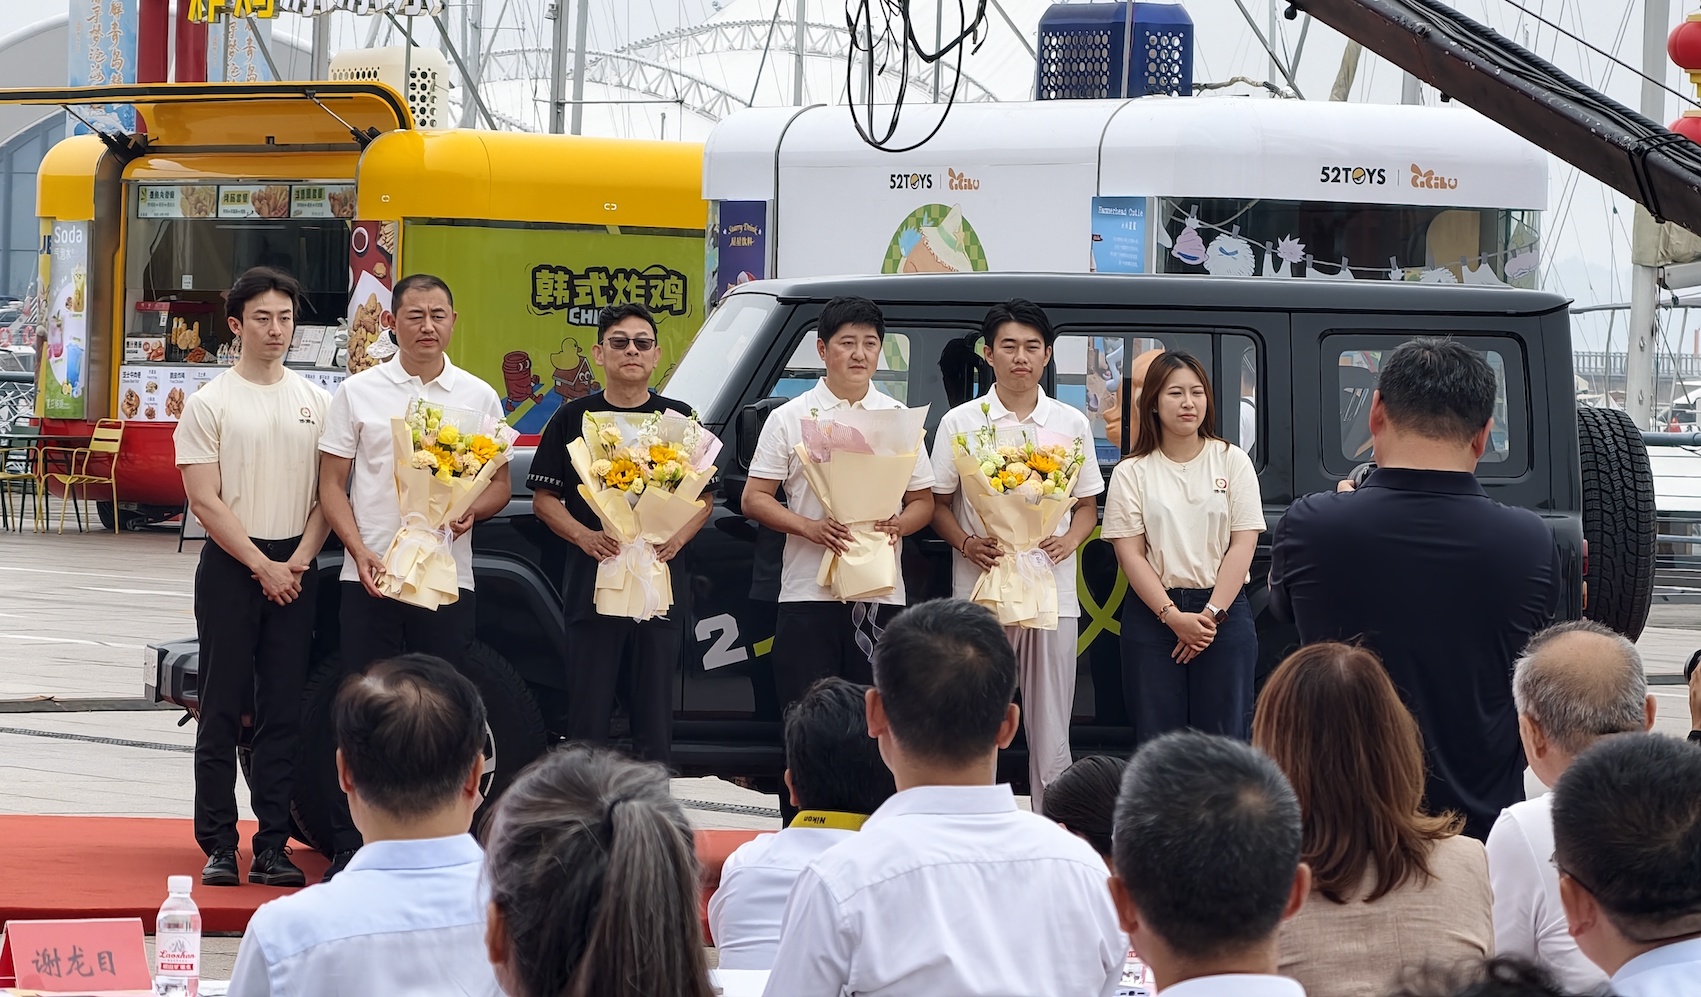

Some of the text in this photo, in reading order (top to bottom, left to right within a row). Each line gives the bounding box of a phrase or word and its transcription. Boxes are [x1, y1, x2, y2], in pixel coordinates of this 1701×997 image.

[889, 173, 933, 190] 52TOYS
[1320, 166, 1386, 185] 52TOYS
[54, 225, 82, 243] Soda
[534, 268, 686, 311] 韩式炸鸡
[694, 613, 749, 671] 2
[803, 815, 827, 824] Nikon
[159, 949, 195, 959] Laoshan
